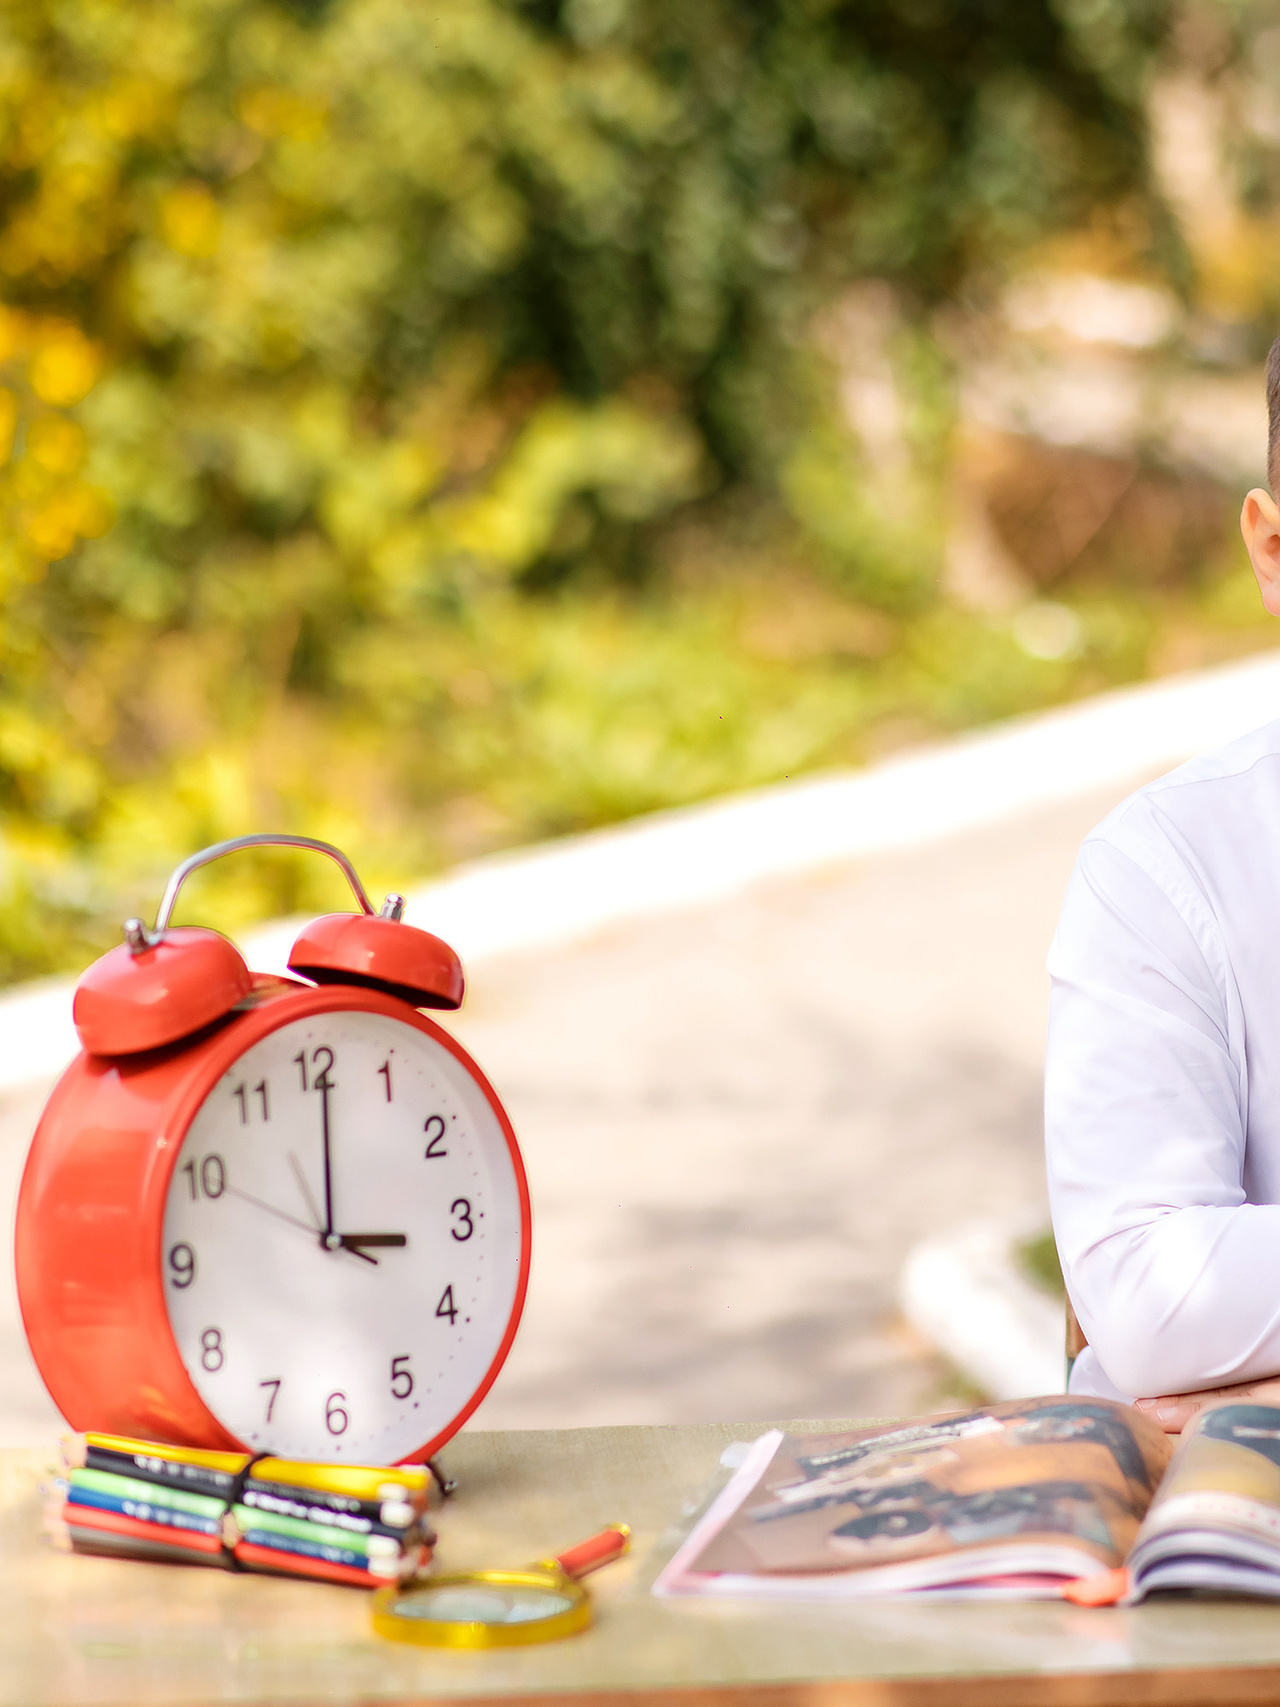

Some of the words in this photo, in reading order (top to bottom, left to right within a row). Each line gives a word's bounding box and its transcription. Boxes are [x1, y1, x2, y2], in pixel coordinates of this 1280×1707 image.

[294, 1046, 336, 1092] 12
[377, 1060, 393, 1103] 1
[233, 1079, 271, 1124] 11
[424, 1115, 448, 1158] 2
[182, 1154, 226, 1202] 10
[450, 1198, 474, 1242] 3
[169, 1243, 194, 1289] 9
[435, 1284, 459, 1326] 4
[200, 1327, 225, 1372] 8
[390, 1356, 414, 1400] 5
[259, 1379, 281, 1424] 7
[325, 1392, 349, 1435] 6
